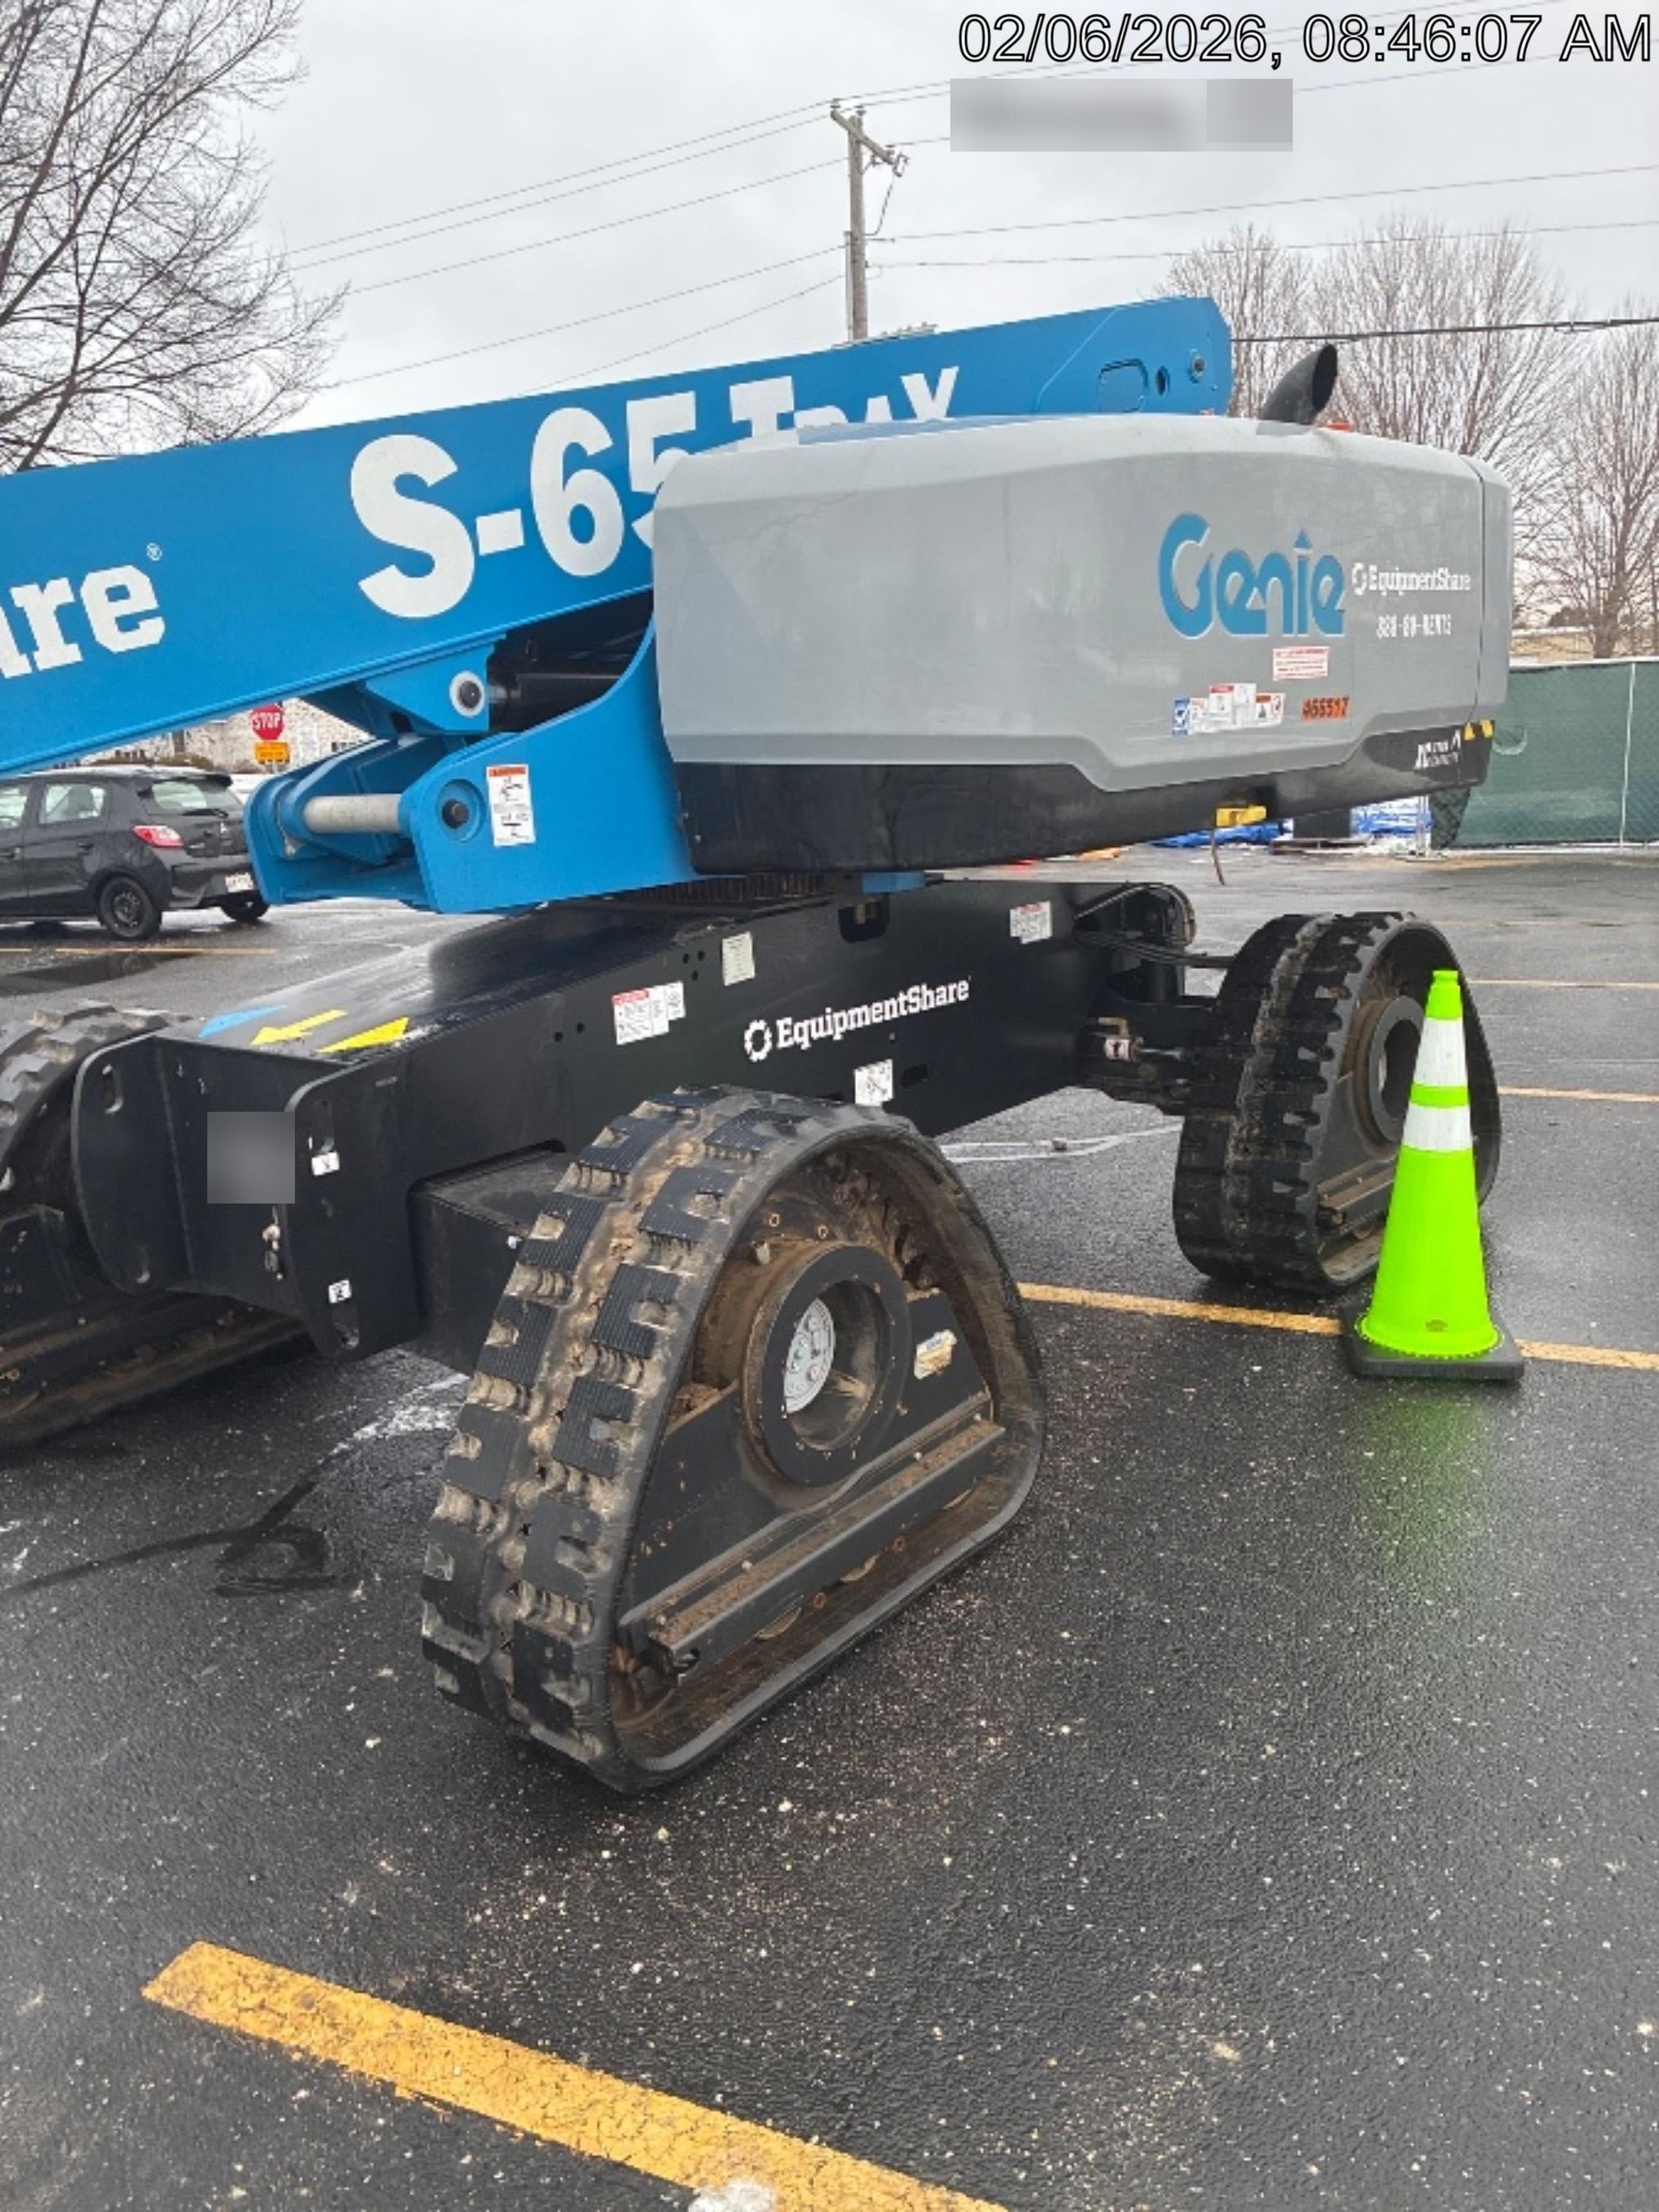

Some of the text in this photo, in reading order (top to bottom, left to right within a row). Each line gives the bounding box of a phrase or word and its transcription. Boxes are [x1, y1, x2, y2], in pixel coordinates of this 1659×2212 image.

[1158, 512, 1345, 639] Genie
[1367, 564, 1471, 596] EquipmentShare
[252, 711, 280, 730] STOP
[776, 978, 970, 1050] EquipmentShare
